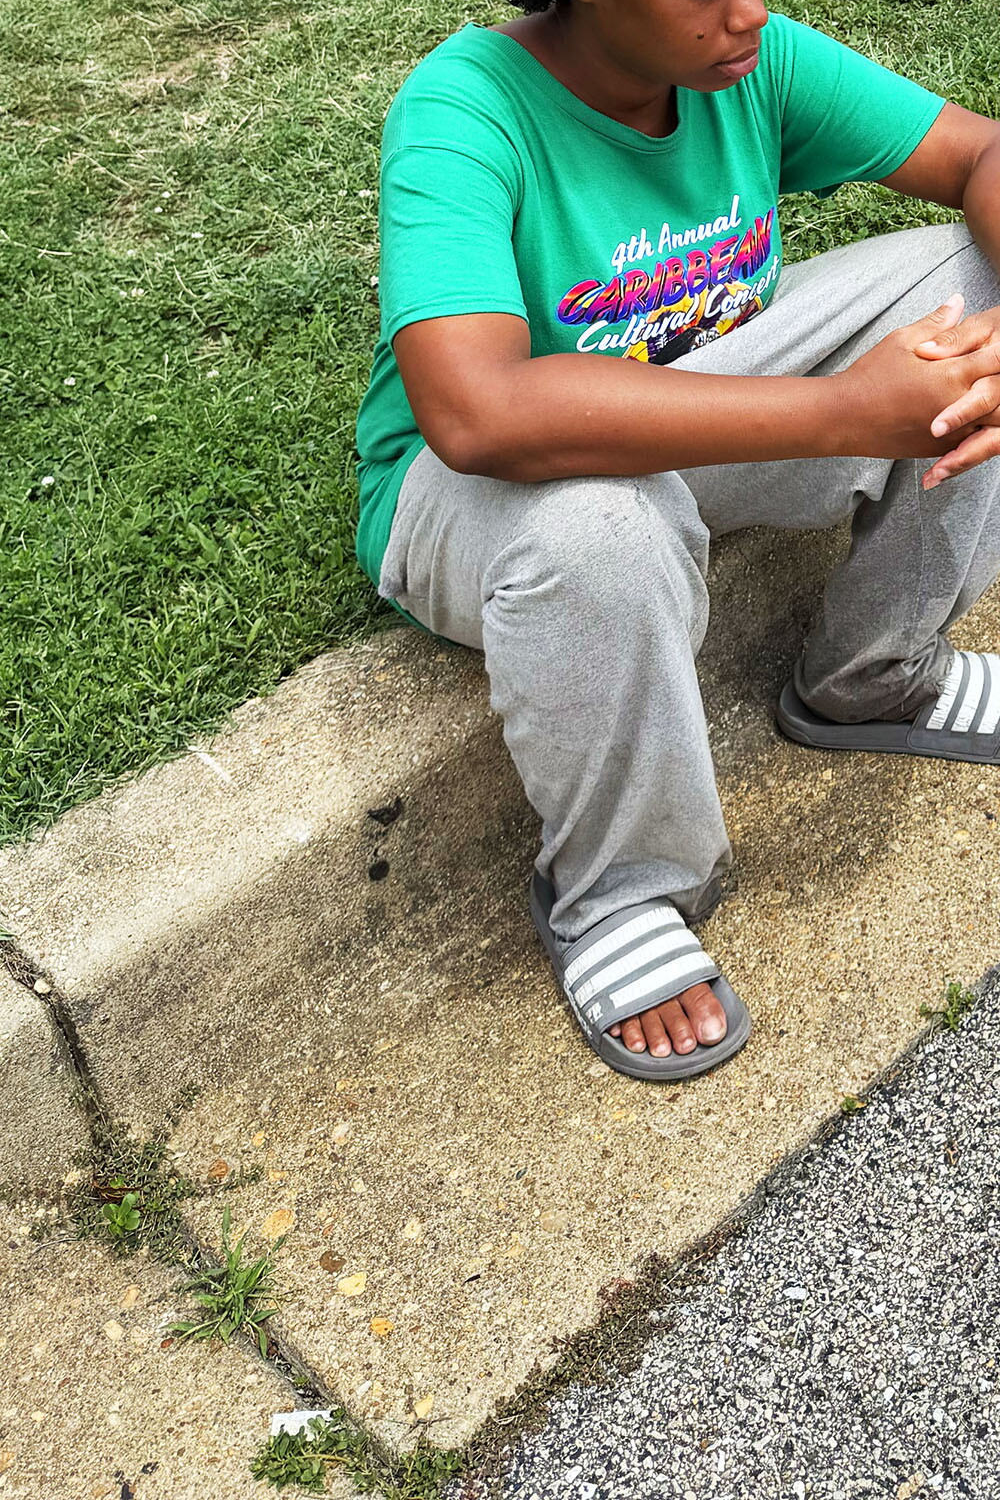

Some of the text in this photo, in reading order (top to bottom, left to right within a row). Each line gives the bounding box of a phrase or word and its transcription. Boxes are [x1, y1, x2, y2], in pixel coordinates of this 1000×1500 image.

[557, 206, 775, 325] CARIBBEAN
[611, 194, 742, 274] 4th Annual
[576, 255, 780, 353] Cultural Concert
